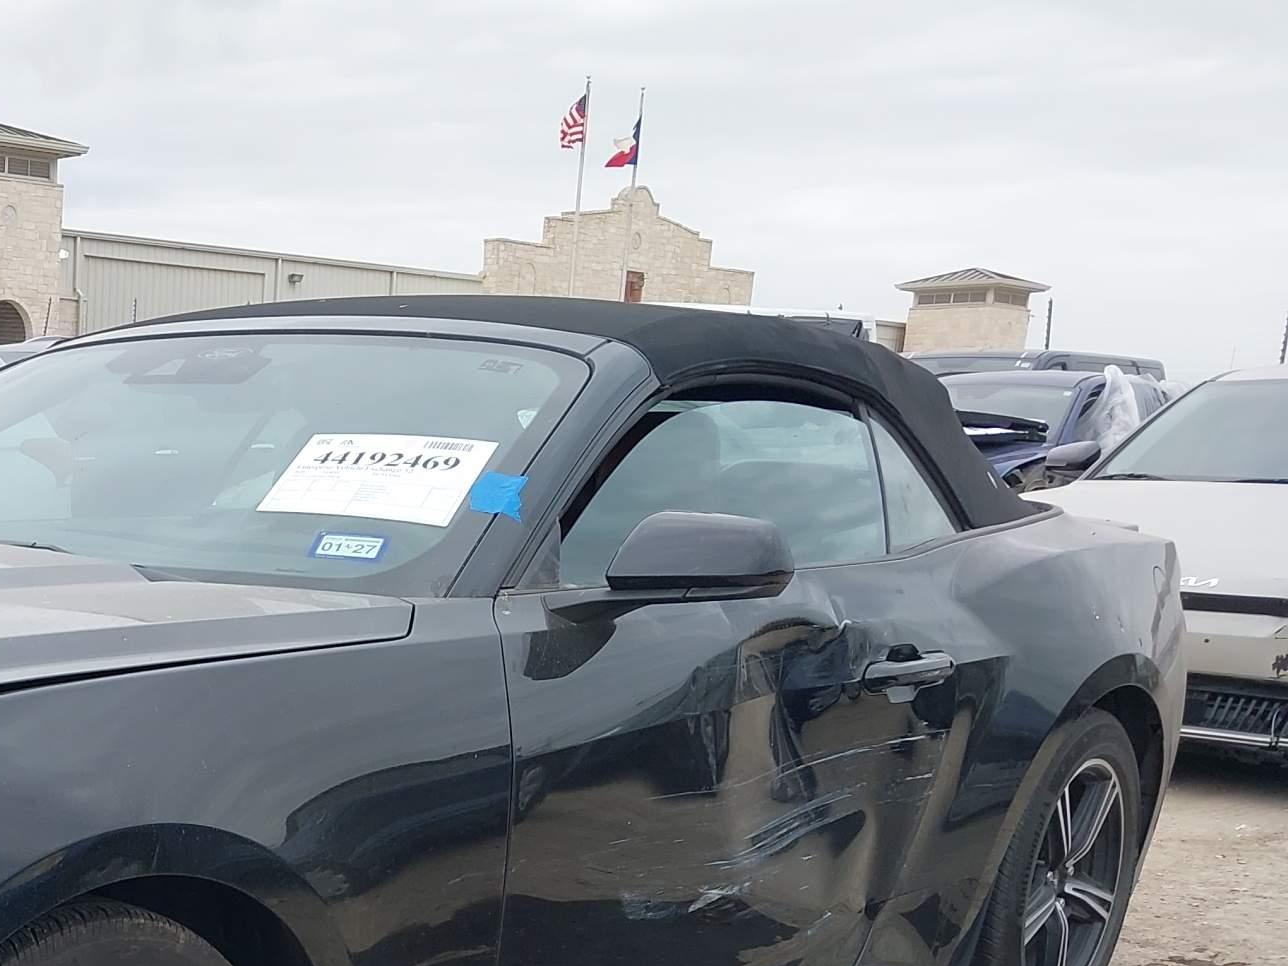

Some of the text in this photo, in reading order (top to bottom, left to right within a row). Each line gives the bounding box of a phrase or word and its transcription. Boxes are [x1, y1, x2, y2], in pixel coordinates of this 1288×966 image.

[314, 451, 461, 471] 44192469
[321, 542, 378, 555] 01 27
